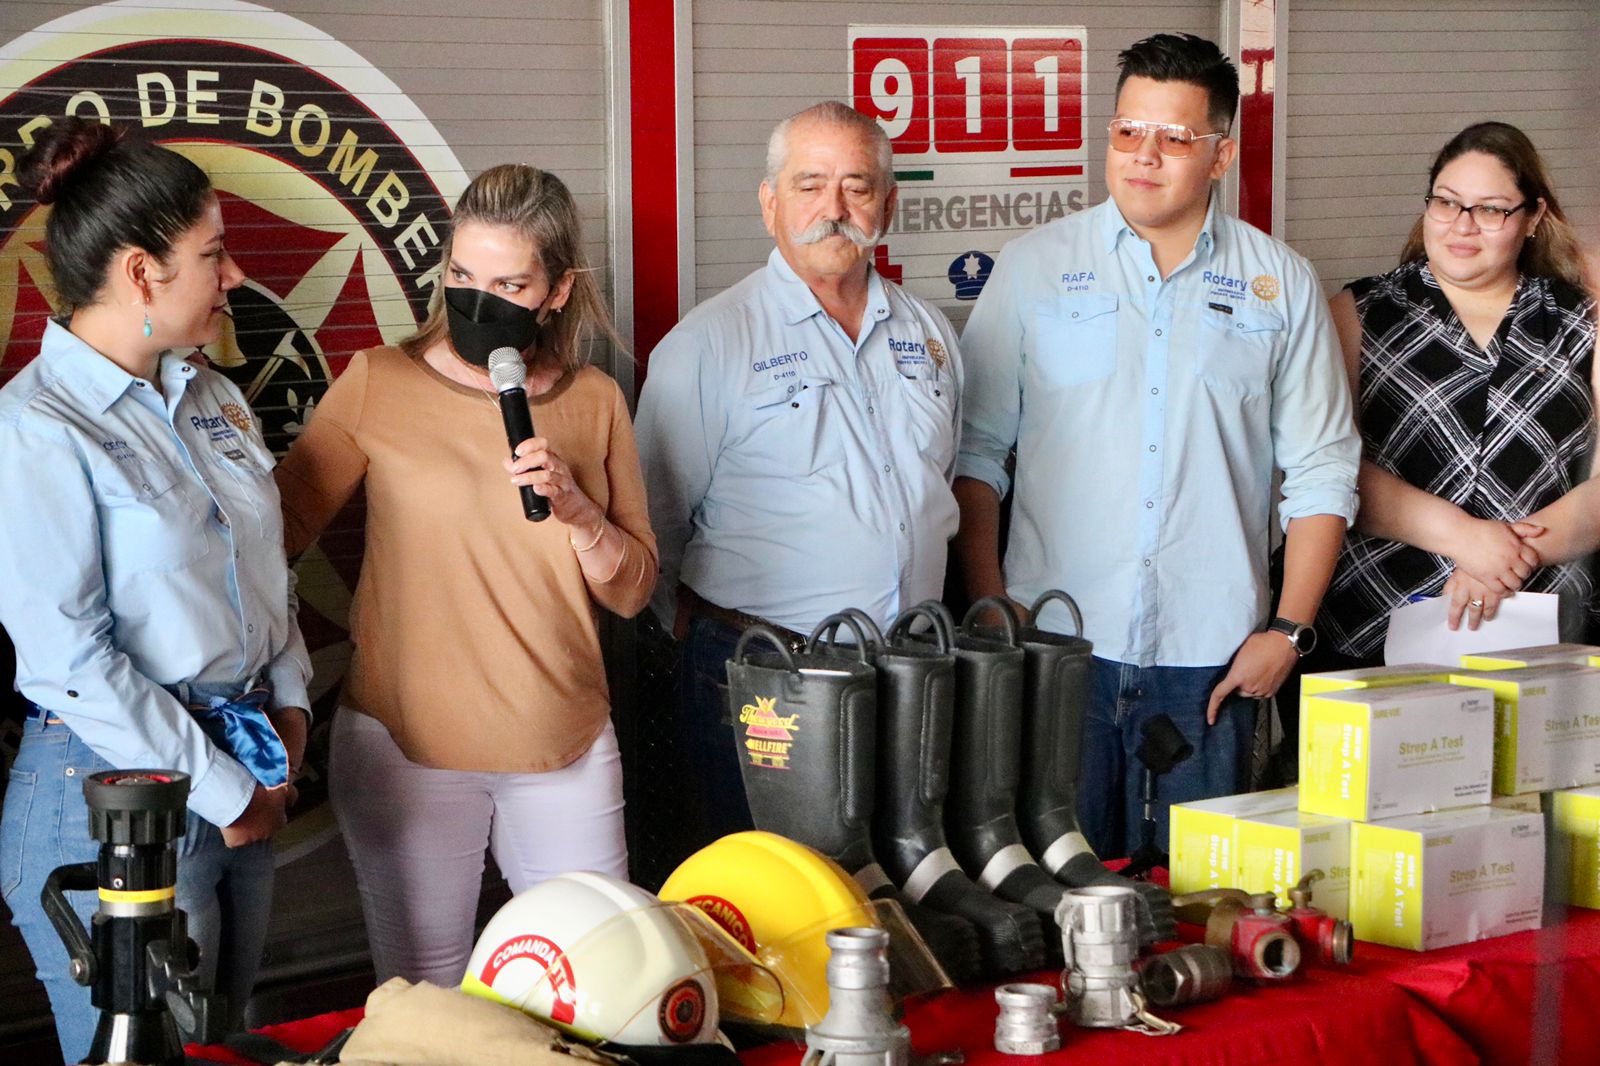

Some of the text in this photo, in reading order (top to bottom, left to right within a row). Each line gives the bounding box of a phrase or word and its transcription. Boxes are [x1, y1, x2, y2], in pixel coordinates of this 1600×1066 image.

[136, 70, 220, 128] DE
[870, 56, 1060, 140] 911
[1062, 271, 1096, 283] RAFA
[1202, 271, 1248, 292] Rotary
[888, 337, 926, 355] Rotary
[752, 350, 809, 373] GILBERTO
[773, 370, 797, 381] D-4110
[191, 415, 230, 432] Rotary
[1399, 735, 1465, 755] Strep A Test
[1341, 724, 1352, 800] Strep A Test
[1210, 870, 1219, 880] A
[1449, 861, 1516, 884] Strep A Test
[1273, 884, 1283, 894] A
[1393, 852, 1405, 929] Strep A Test
